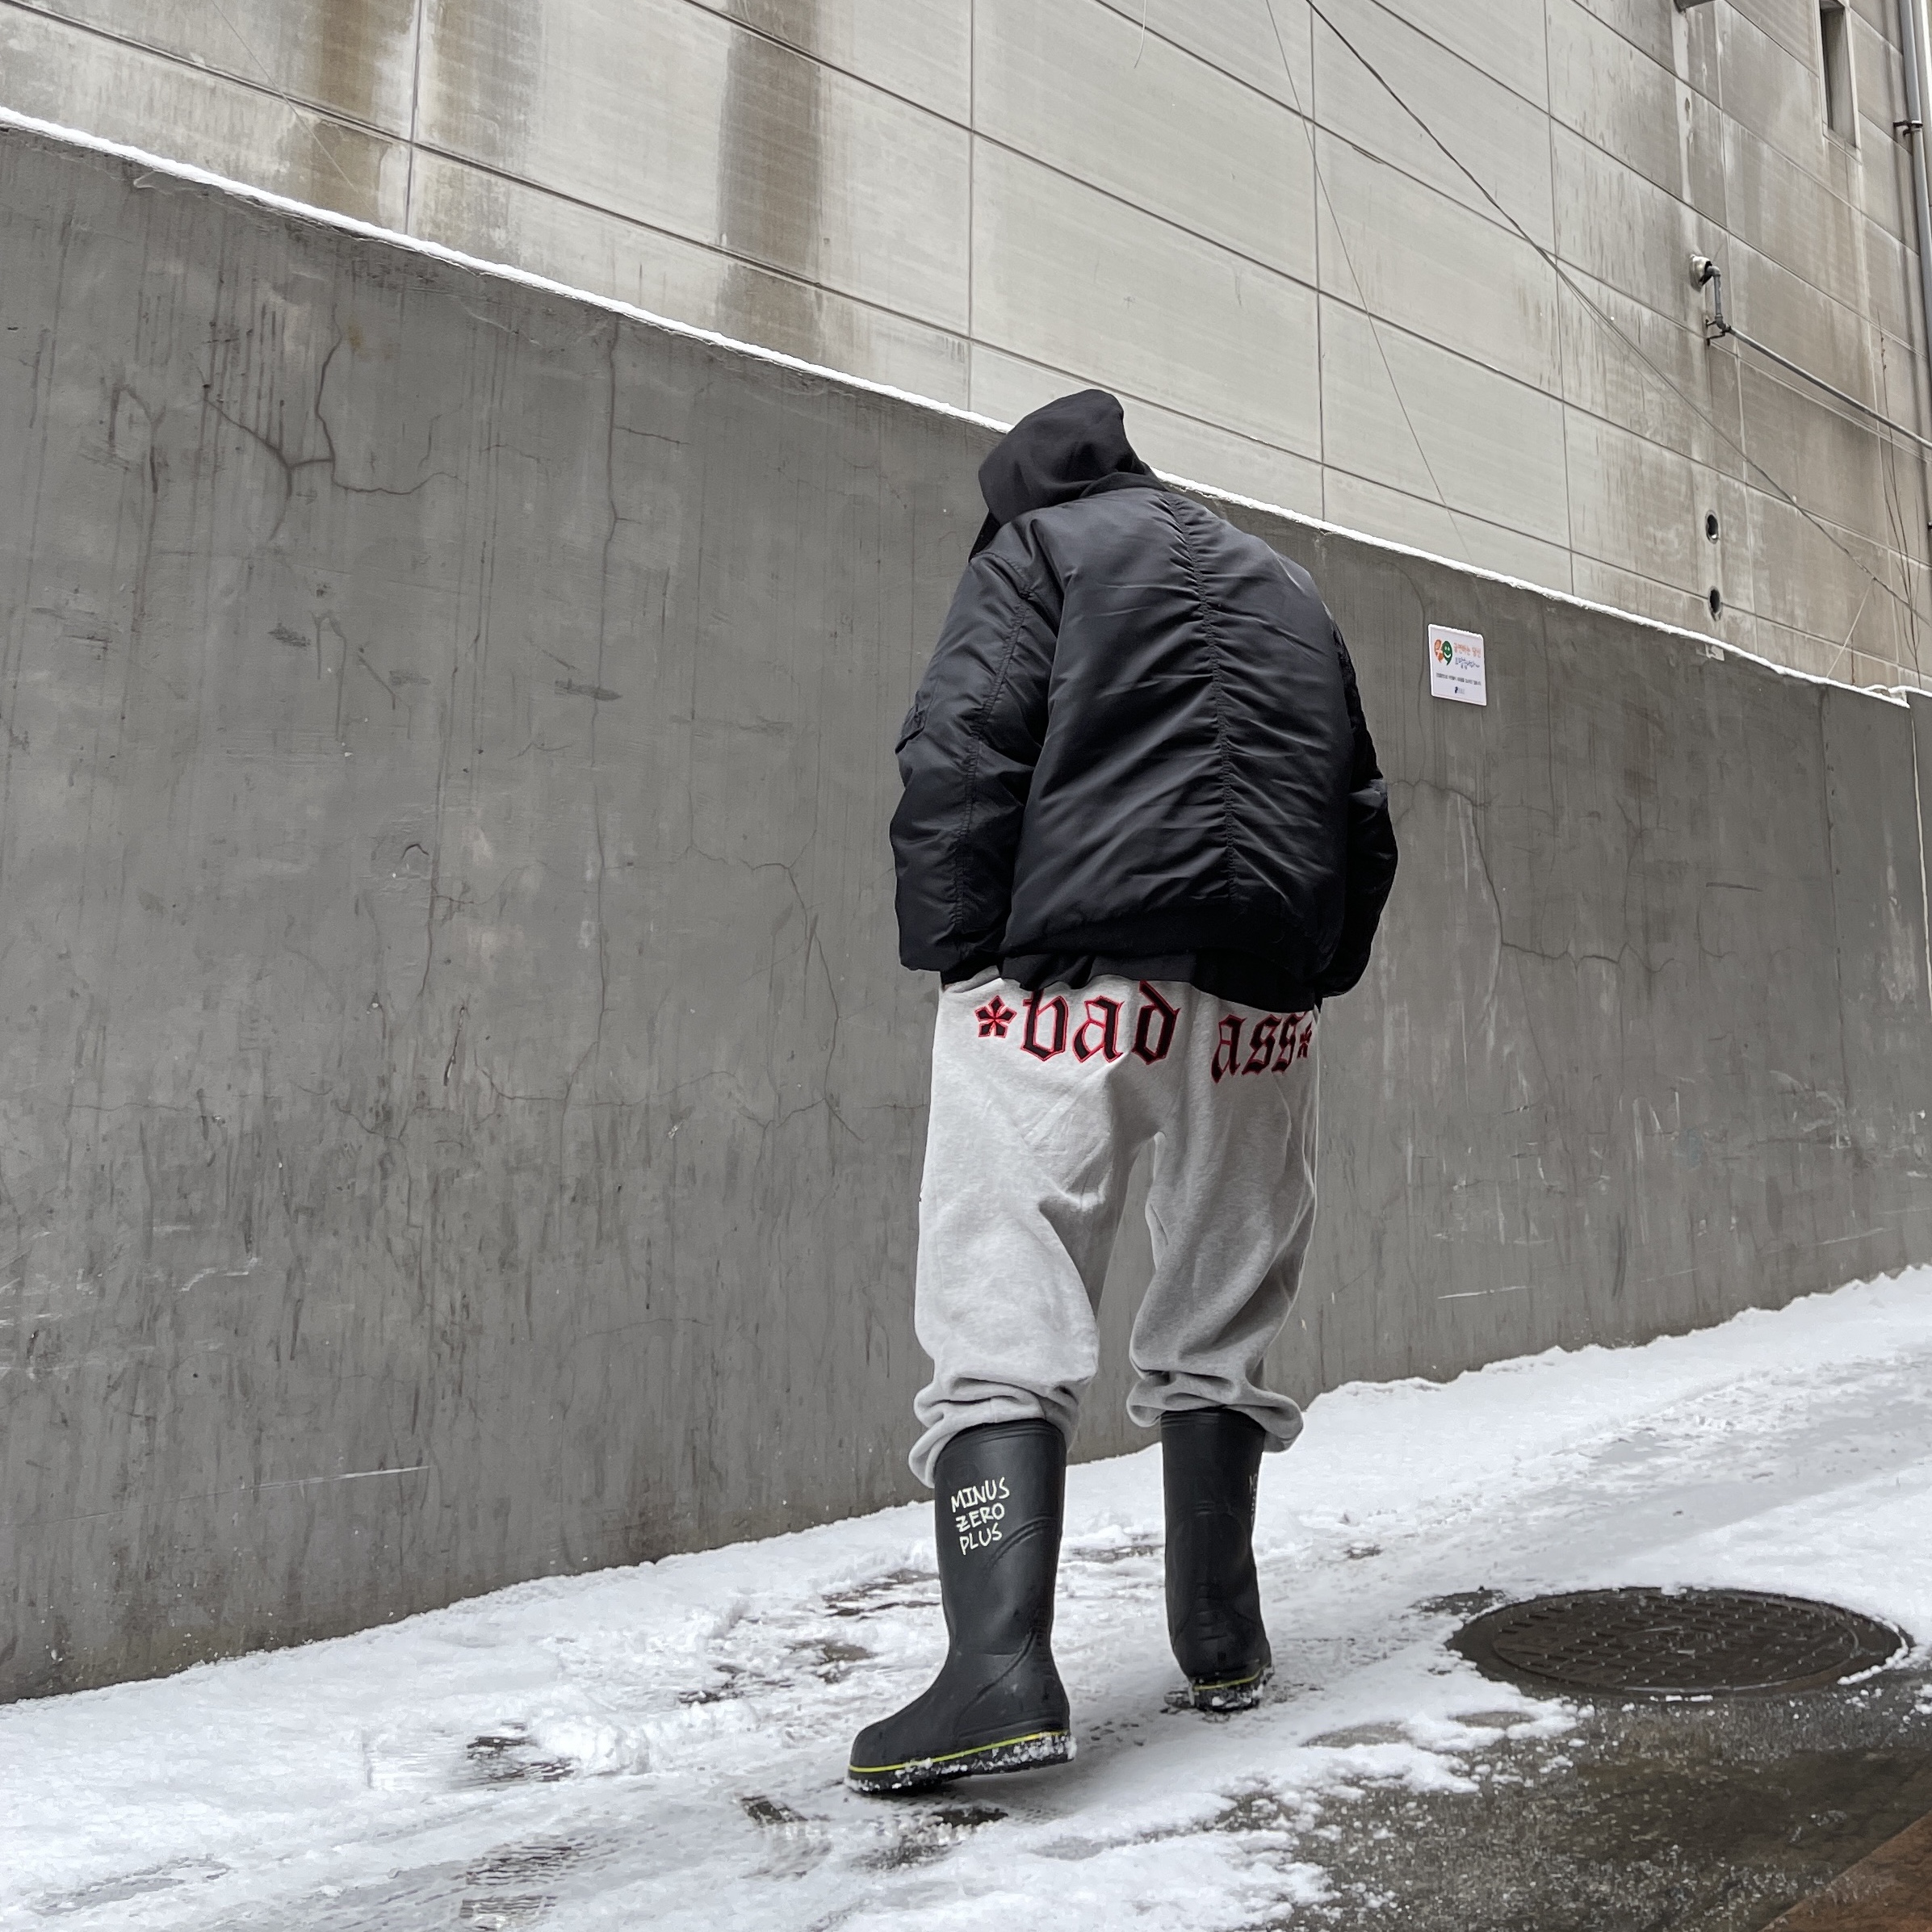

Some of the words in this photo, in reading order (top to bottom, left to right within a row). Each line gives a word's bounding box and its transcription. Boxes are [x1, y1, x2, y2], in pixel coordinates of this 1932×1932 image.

[951, 1477, 1010, 1513] MINUS
[955, 1502, 1005, 1532] ZERO
[959, 1522, 1003, 1555] PLUS
